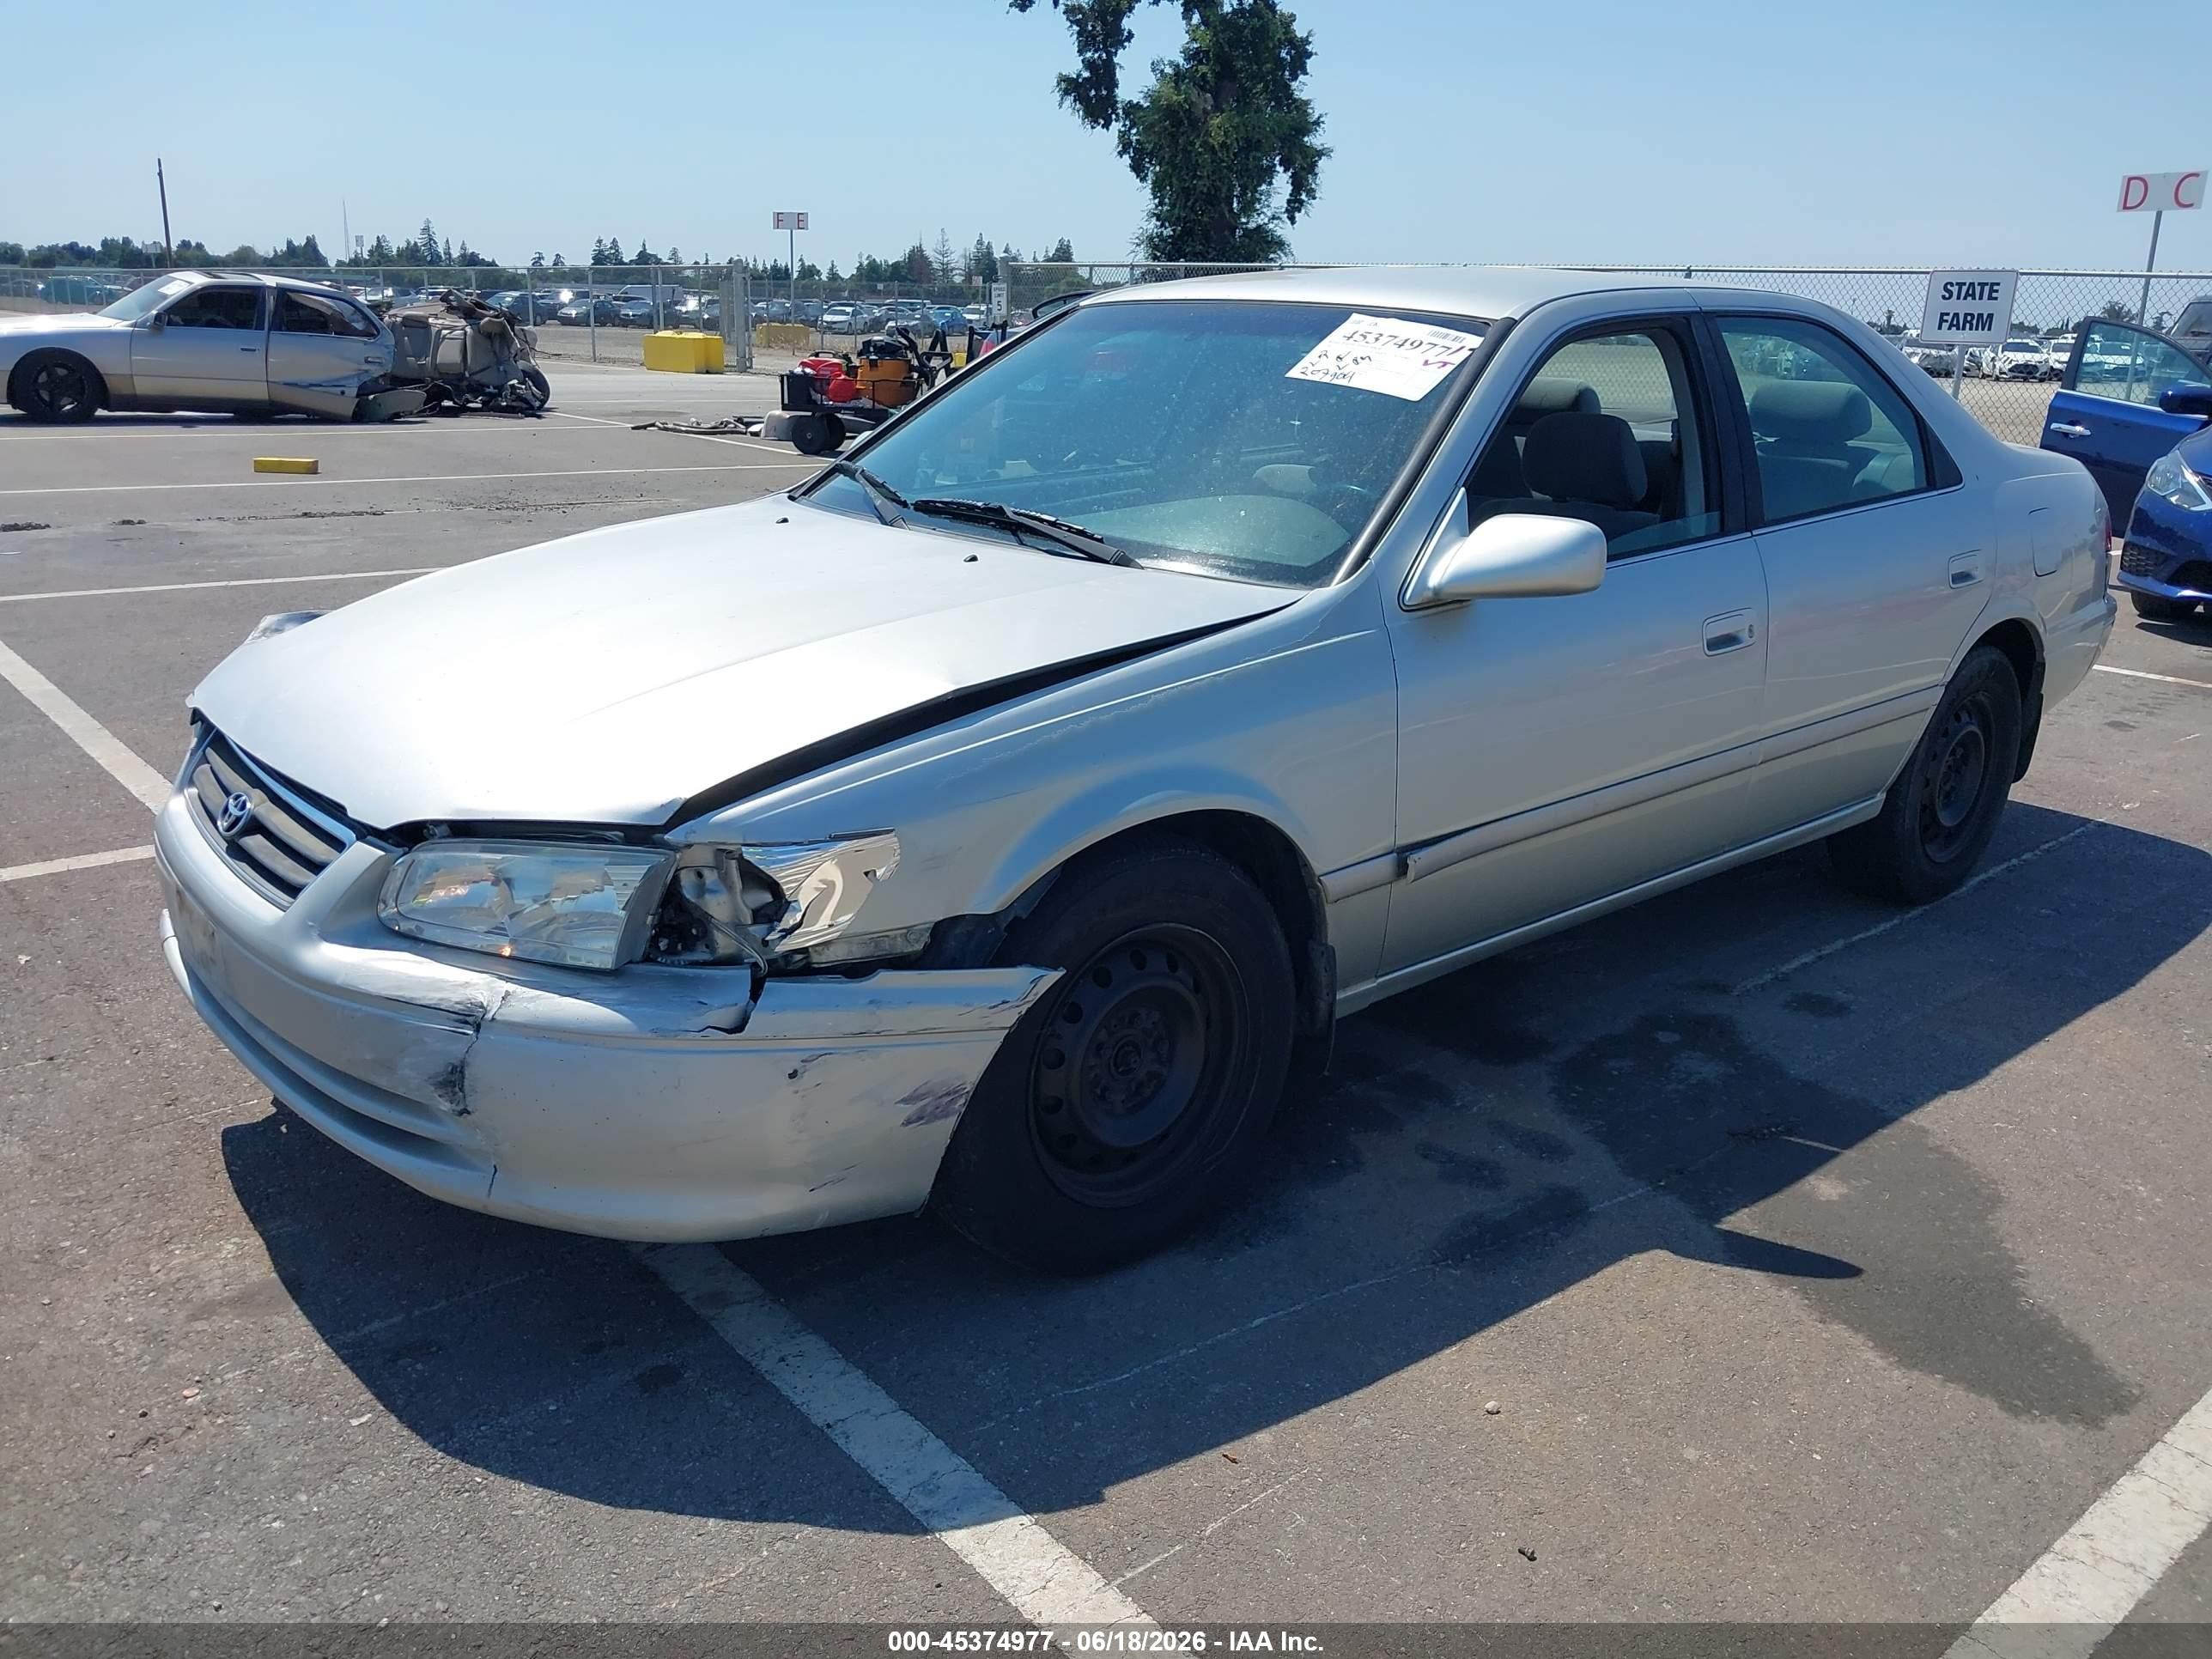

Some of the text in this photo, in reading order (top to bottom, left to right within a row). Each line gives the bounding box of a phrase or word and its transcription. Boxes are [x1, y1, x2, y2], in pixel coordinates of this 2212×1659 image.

[2123, 173, 2200, 210] D C
[777, 212, 805, 229] F E
[1942, 282, 2001, 301] STATE
[996, 301, 1002, 311] 5
[1937, 312, 1994, 331] FARM
